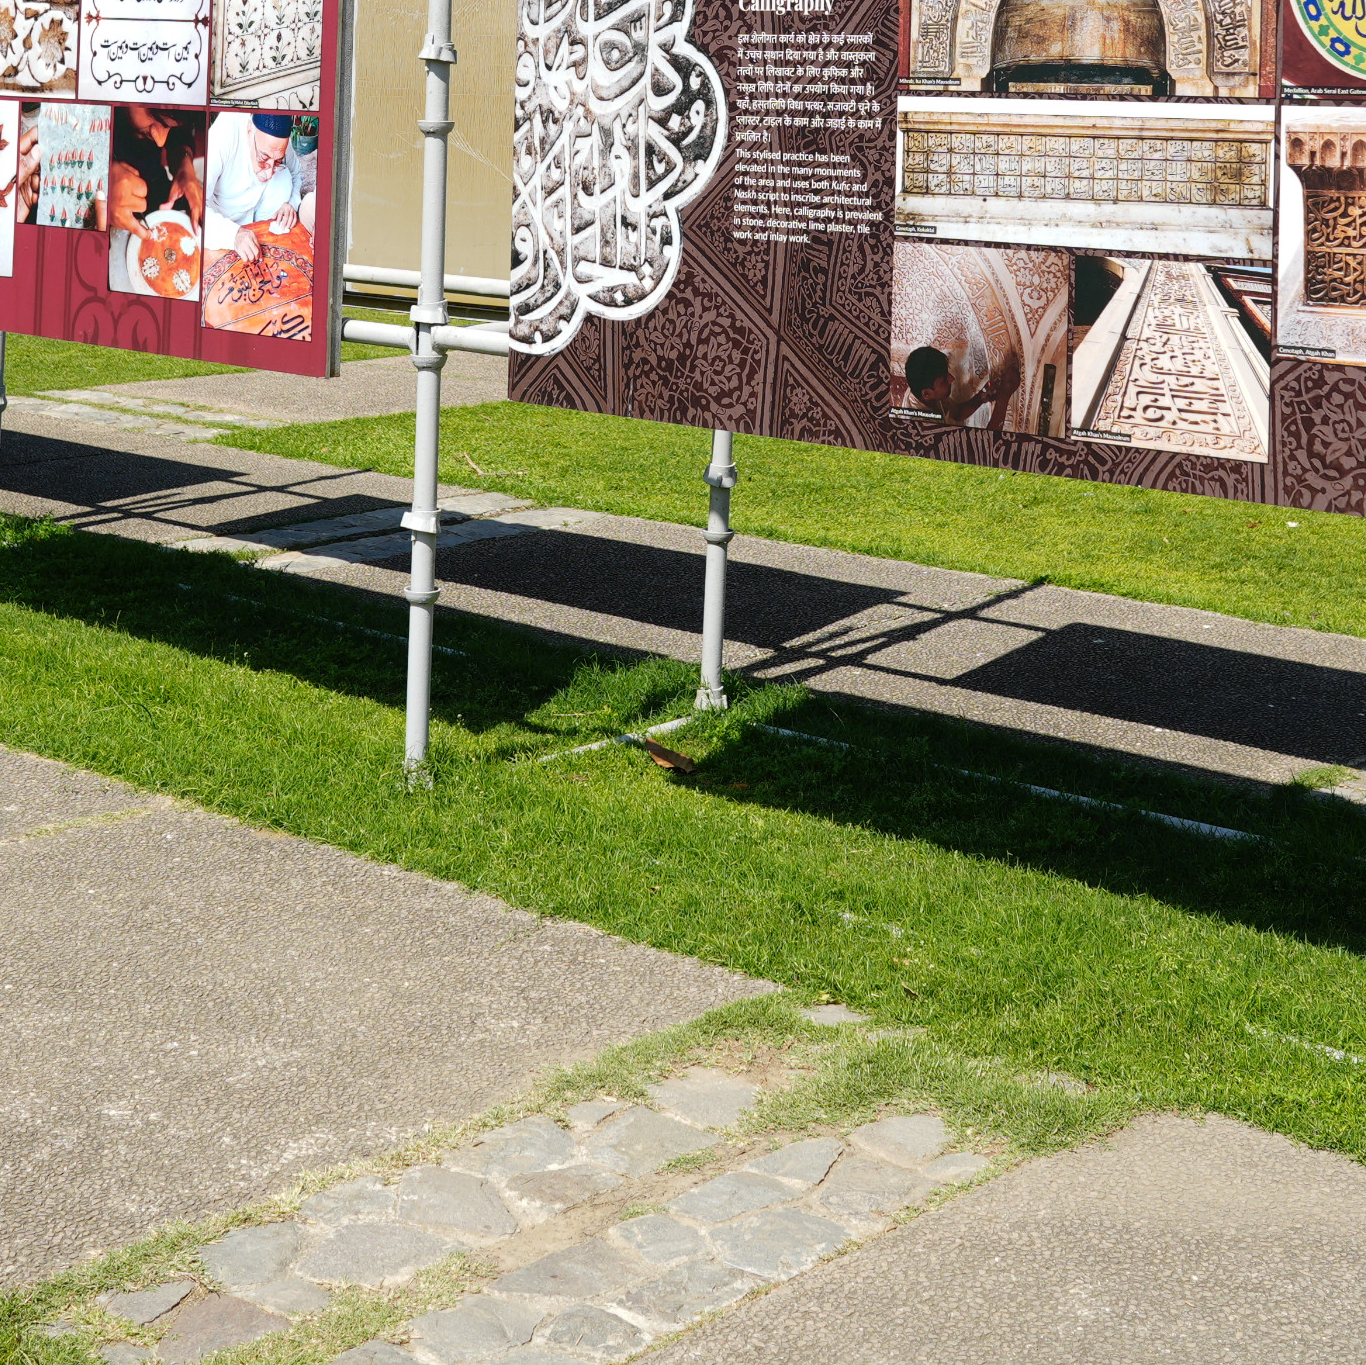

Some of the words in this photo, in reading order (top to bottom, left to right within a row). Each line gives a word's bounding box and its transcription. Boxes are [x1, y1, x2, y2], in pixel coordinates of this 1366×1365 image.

[738, 34, 749, 45] इस
[751, 31, 777, 44] शैलीगत
[779, 32, 794, 43] कार्य
[796, 32, 806, 44] को
[808, 32, 819, 44] क्षेत्र
[822, 32, 830, 43] के
[832, 32, 845, 46] कई
[847, 32, 873, 44] स्मारकों
[786, 49, 801, 61] दिया
[803, 51, 817, 61] गया
[818, 48, 824, 61] है
[826, 49, 839, 61] और
[841, 52, 875, 64] वास्तुकला
[755, 67, 764, 76] पर
[766, 65, 795, 77] लिखावट
[797, 65, 804, 76] के
[806, 65, 820, 77] लिए
[850, 66, 864, 78] और
[758, 81, 773, 93] लिपि
[776, 82, 791, 93] दोनों
[792, 84, 802, 93] का
[804, 82, 828, 94] उपयोग
[830, 84, 848, 94] किया
[851, 85, 864, 95] गया
[1284, 87, 1310, 95] Medallion,
[787, 99, 803, 110] विधा
[827, 100, 856, 112] सजावटी
[858, 100, 870, 115] चूने
[872, 100, 880, 112] के
[763, 116, 782, 127] टाइल
[784, 115, 792, 127] के
[793, 118, 808, 127] काम
[811, 115, 824, 128] और
[848, 117, 856, 129] के
[858, 119, 873, 129] काम
[736, 130, 761, 142] प्रचलित
[736, 149, 751, 158] This
[753, 150, 780, 161] stylised
[783, 151, 813, 162] practice
[816, 152, 828, 162] has
[831, 153, 850, 163] been
[735, 163, 766, 172] elevated
[769, 163, 775, 172] in
[777, 165, 790, 173] the
[792, 167, 813, 177] many
[815, 168, 861, 178] monuments
[735, 176, 743, 185] of
[745, 177, 756, 185] the
[758, 179, 774, 187] area
[776, 179, 790, 187] and
[812, 180, 830, 190] both
[832, 182, 850, 192] Kufic
[852, 182, 867, 192] and
[735, 189, 756, 199] Naskh
[758, 191, 779, 201] script
[781, 192, 789, 201] to
[791, 192, 821, 203] inscribe
[823, 195, 871, 205] architectural
[734, 204, 769, 214] elements.
[772, 205, 792, 215] Here,
[794, 206, 835, 220] calligraphy
[837, 209, 843, 218] is
[845, 210, 882, 221] prevalent
[734, 216, 741, 225] in
[742, 218, 765, 228] stone,
[767, 218, 806, 230] decorative
[809, 220, 825, 231] lime
[827, 222, 855, 235] plaster,
[858, 224, 870, 233] tile
[734, 231, 752, 239] work
[754, 232, 768, 241] and
[770, 232, 787, 243] inlay
[789, 234, 810, 243] work.
